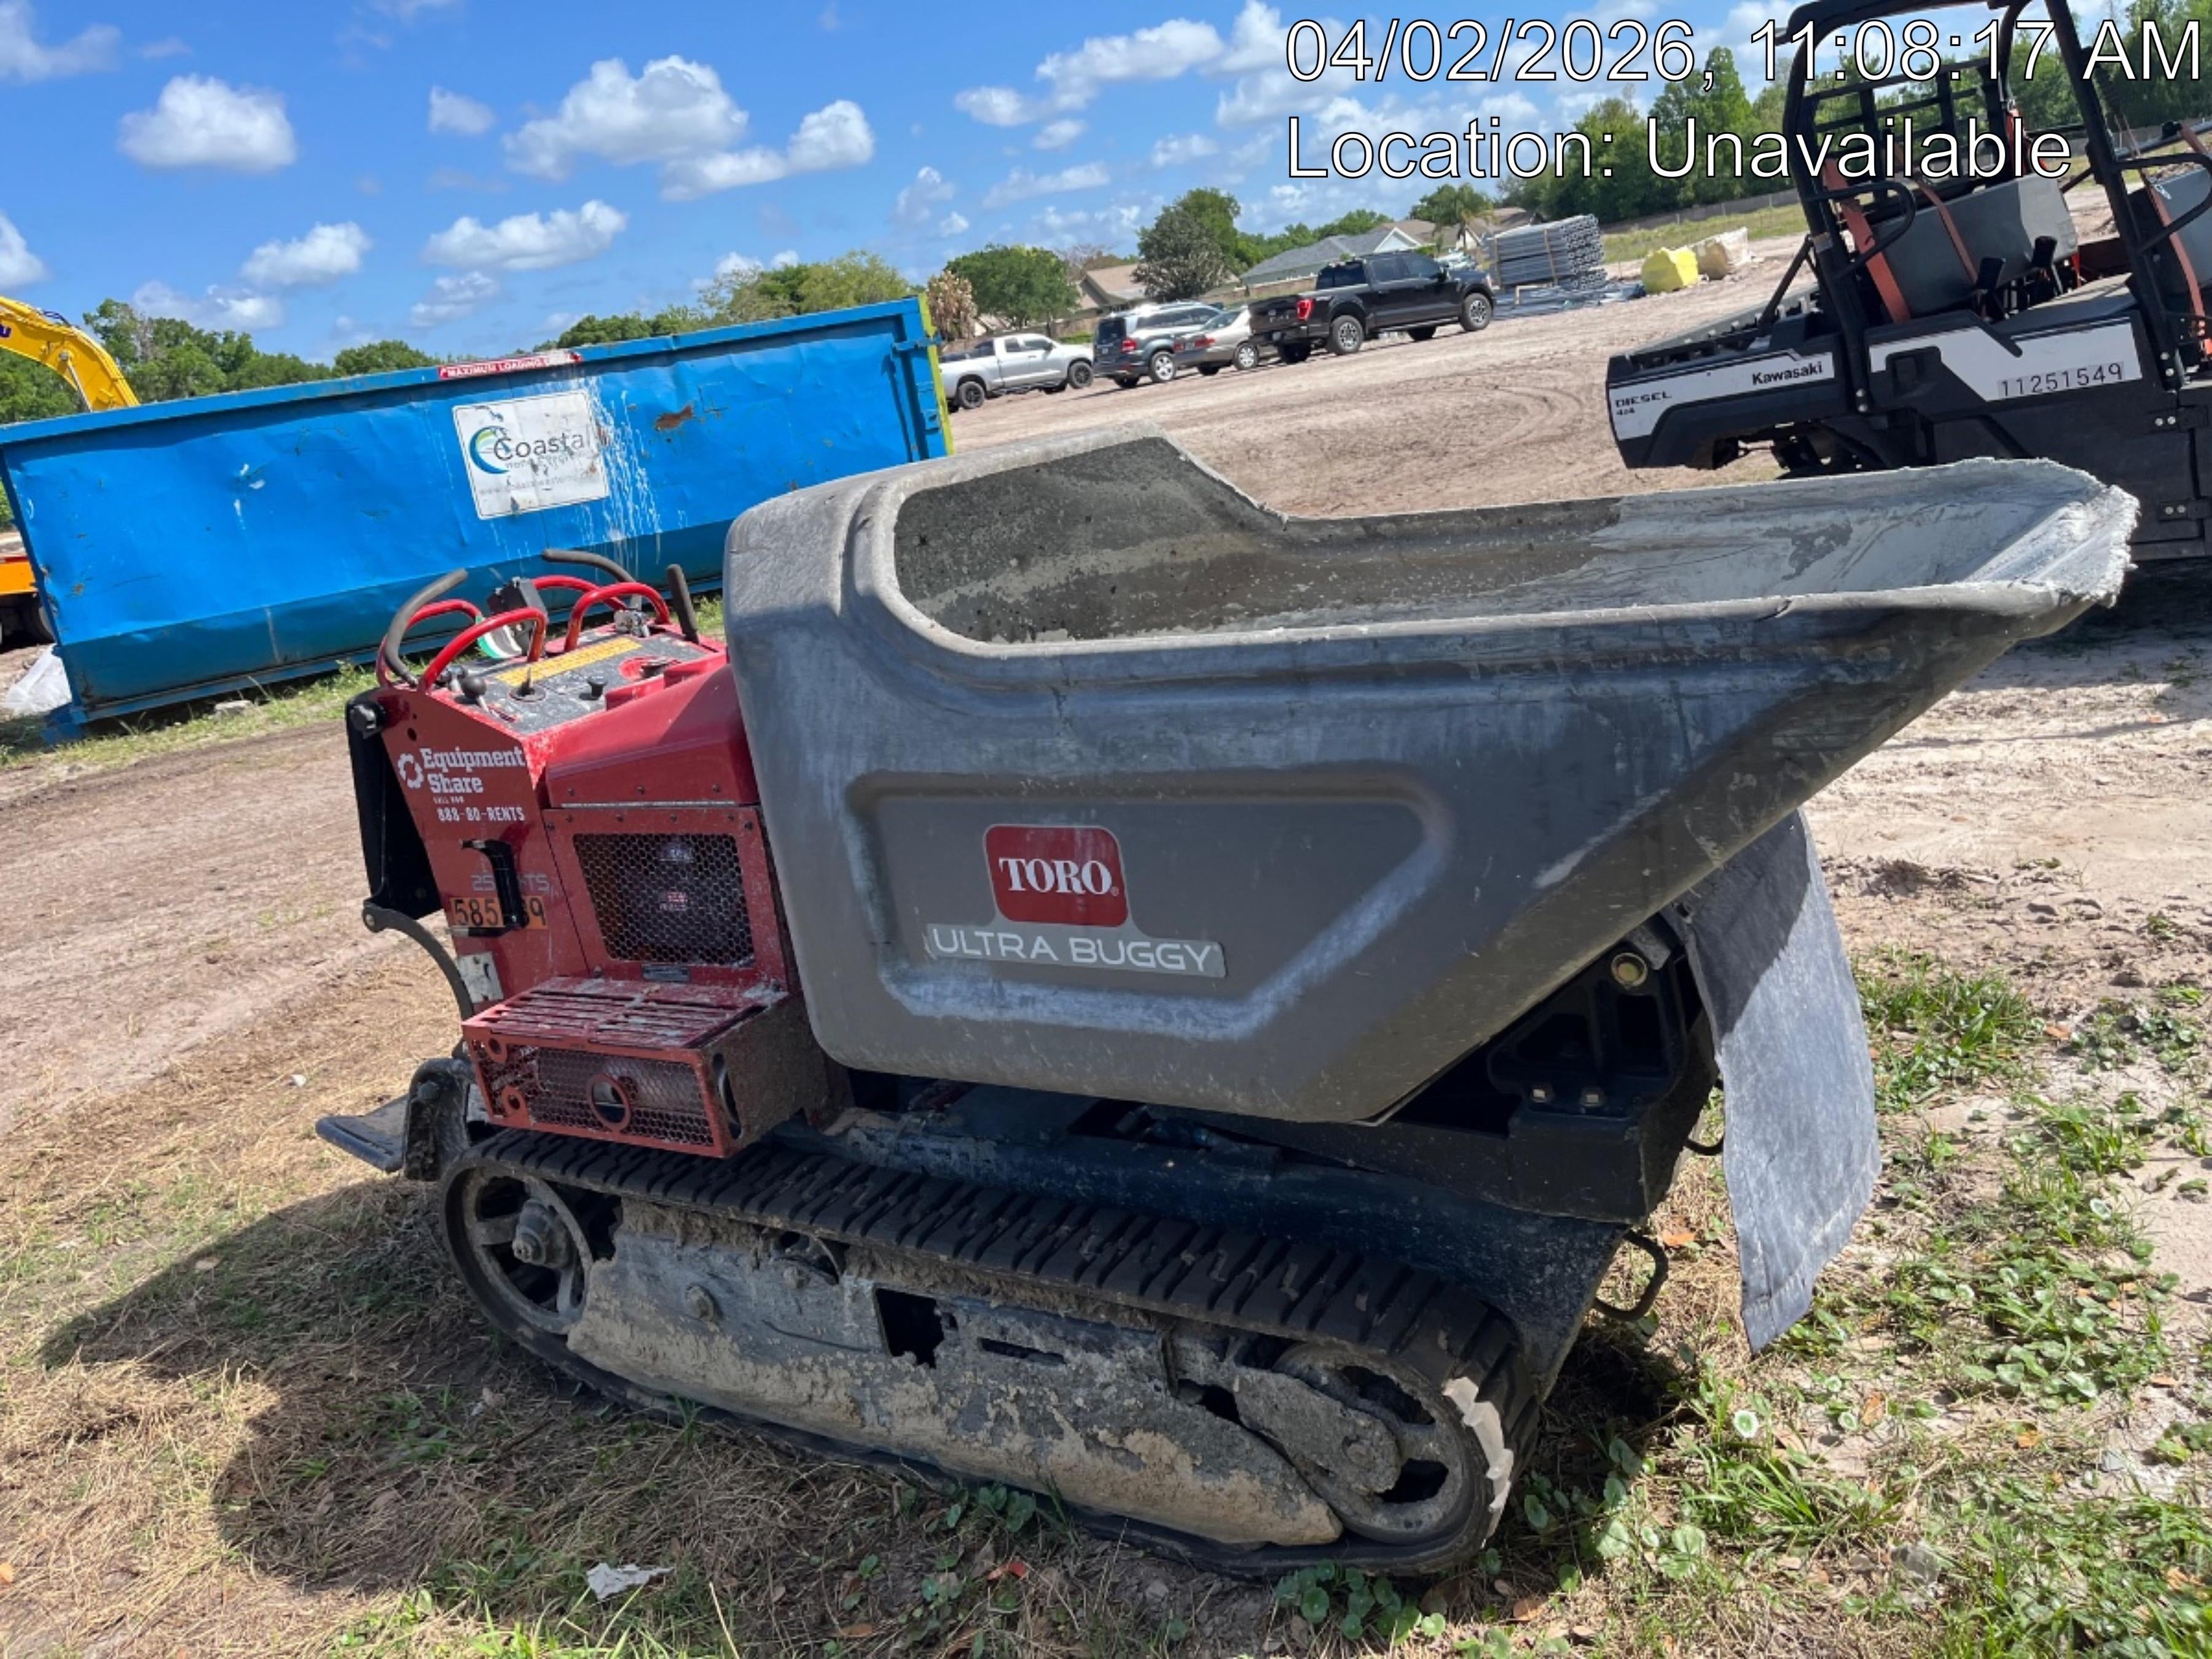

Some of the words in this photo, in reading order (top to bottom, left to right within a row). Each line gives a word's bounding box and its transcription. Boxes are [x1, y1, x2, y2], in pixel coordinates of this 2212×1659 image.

[1752, 361, 1824, 386] Kawasaki
[2001, 362, 2123, 397] 11251549
[1615, 390, 1673, 408] DIESEL
[419, 745, 526, 774] Equipment
[427, 773, 484, 794] Share
[437, 807, 526, 822] 888-80-RENTS
[999, 857, 1112, 895] TORO
[933, 928, 1059, 961] ULTRA
[1068, 938, 1212, 971] BUGGY
